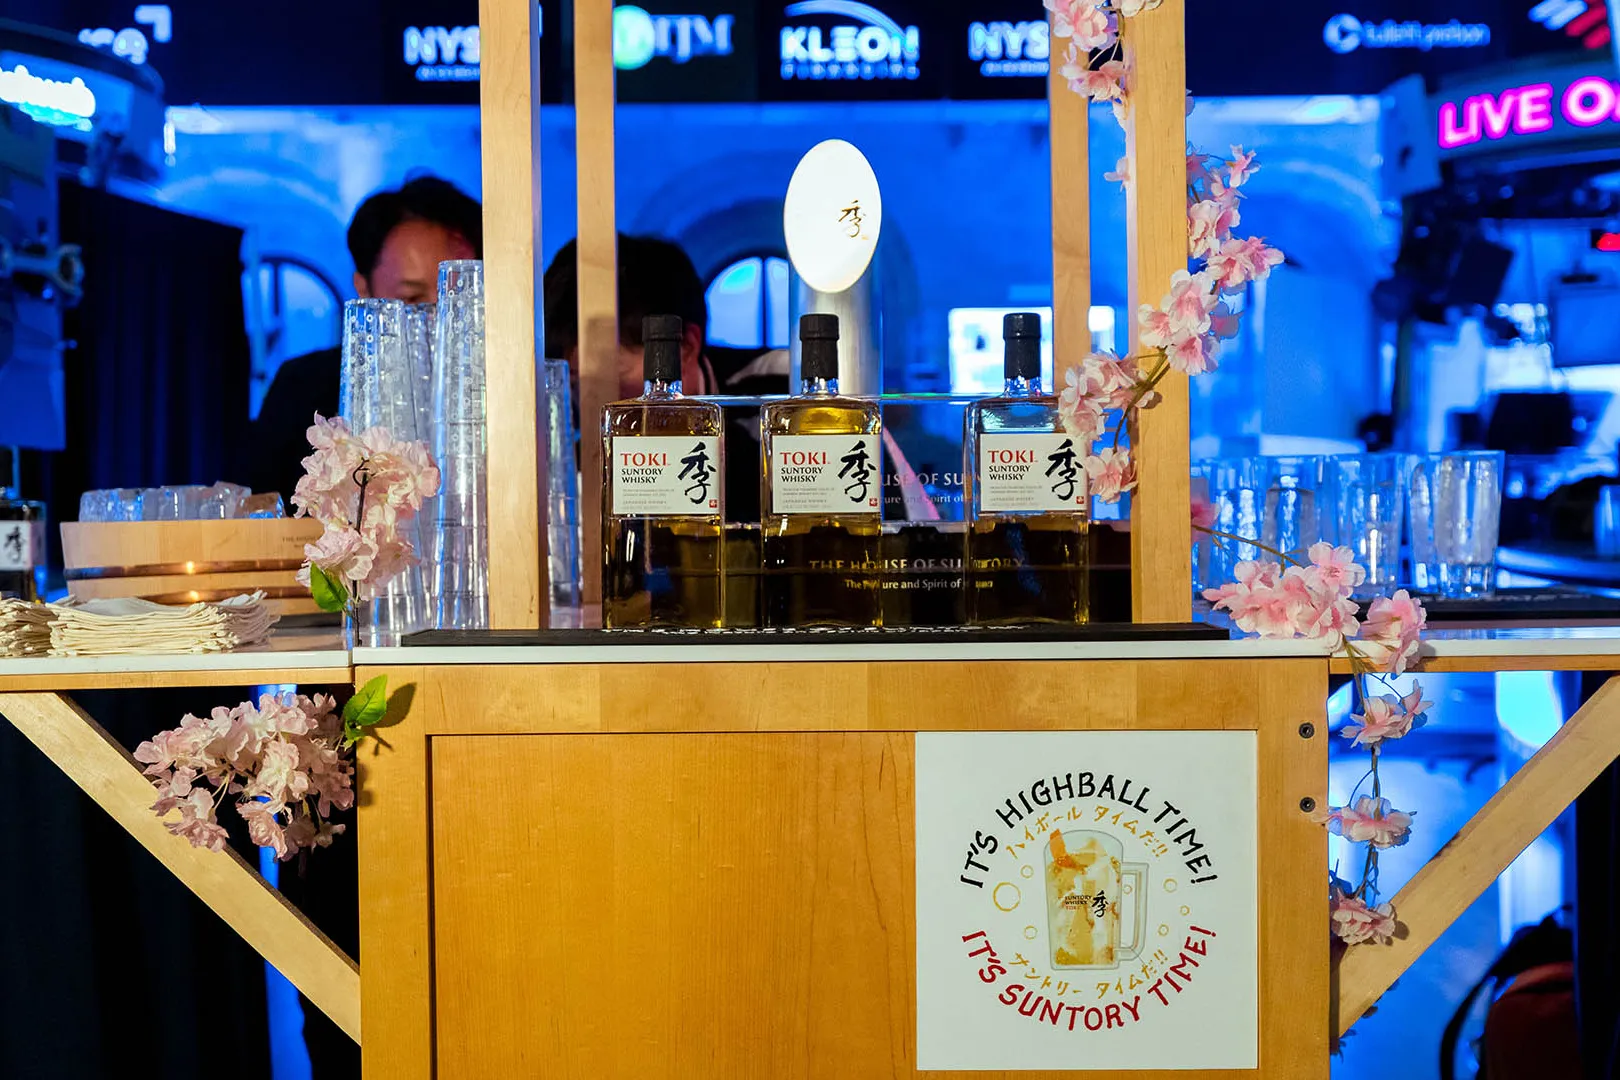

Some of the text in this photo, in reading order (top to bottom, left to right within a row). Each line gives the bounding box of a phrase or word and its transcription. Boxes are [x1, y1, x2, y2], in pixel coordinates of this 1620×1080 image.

[780, 25, 919, 63] KLEON
[1438, 76, 1620, 149] LIVE O
[838, 199, 867, 238] 季
[620, 452, 668, 467] TOKI
[779, 451, 827, 466] TOKI
[987, 449, 1035, 464] TOKI
[621, 468, 664, 476] SUNTORY
[677, 441, 717, 505] 季
[781, 467, 824, 475] SUNTORY
[837, 440, 877, 503] 季
[988, 465, 1031, 473] SUNTORY
[1044, 438, 1084, 501] 季
[621, 476, 658, 484] WHISKY
[781, 475, 818, 483] WHISKY
[988, 473, 1024, 481] WHISKY
[912, 558, 936, 570] OF
[900, 578, 920, 589] and
[922, 578, 948, 591] Spirit
[950, 577, 962, 589] of
[960, 771, 1219, 889] IT'S HIGHBALL TIME!
[1091, 889, 1109, 918] 季
[961, 924, 1217, 1032] IT'S SUNTORY TIME!
